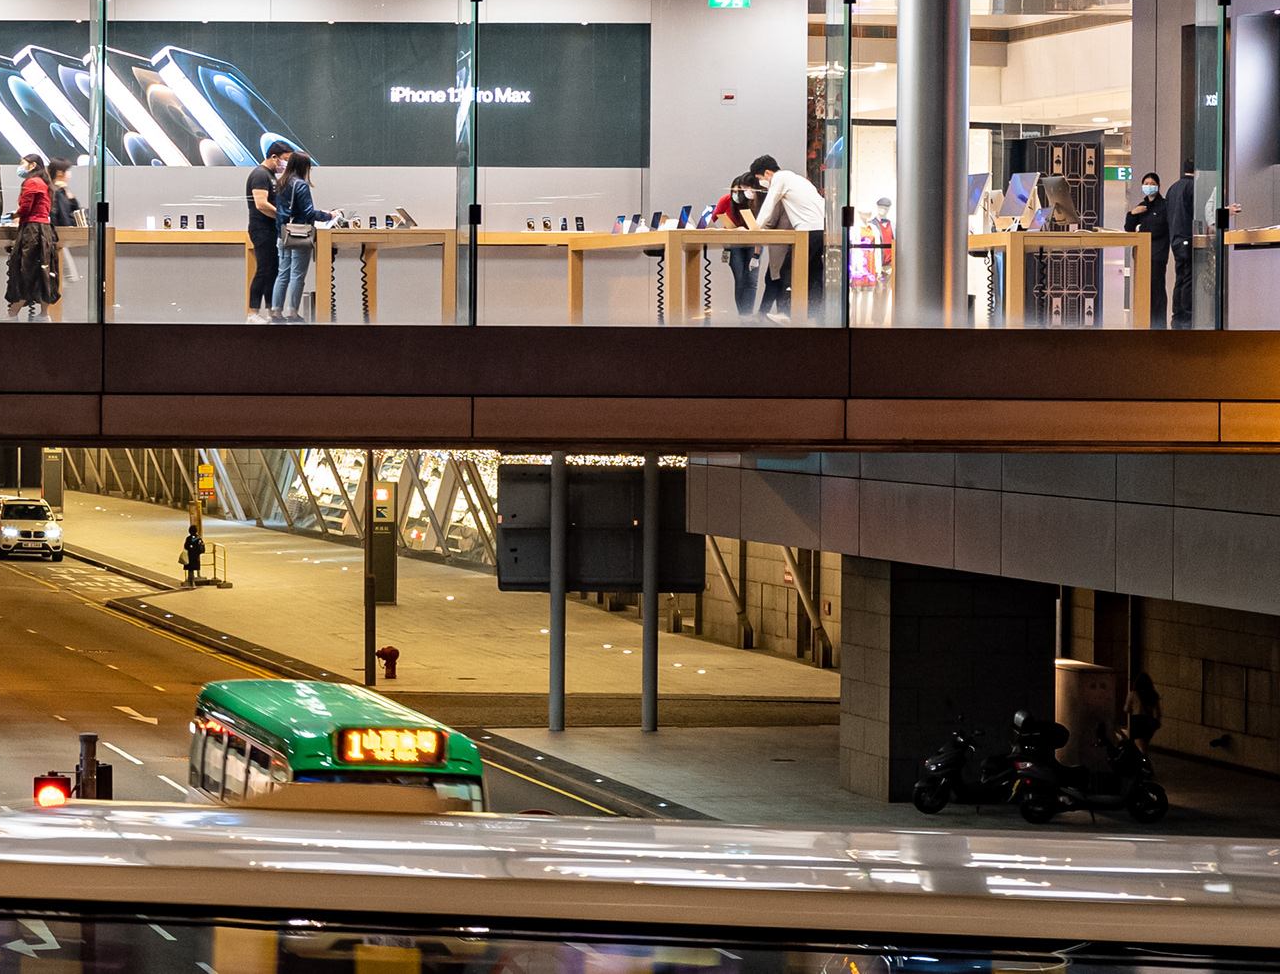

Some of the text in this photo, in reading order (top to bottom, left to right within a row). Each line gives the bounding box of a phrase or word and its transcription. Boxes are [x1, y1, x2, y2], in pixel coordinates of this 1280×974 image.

[390, 86, 446, 103] iPhone
[495, 87, 531, 103] Max
[348, 731, 363, 758] 1
